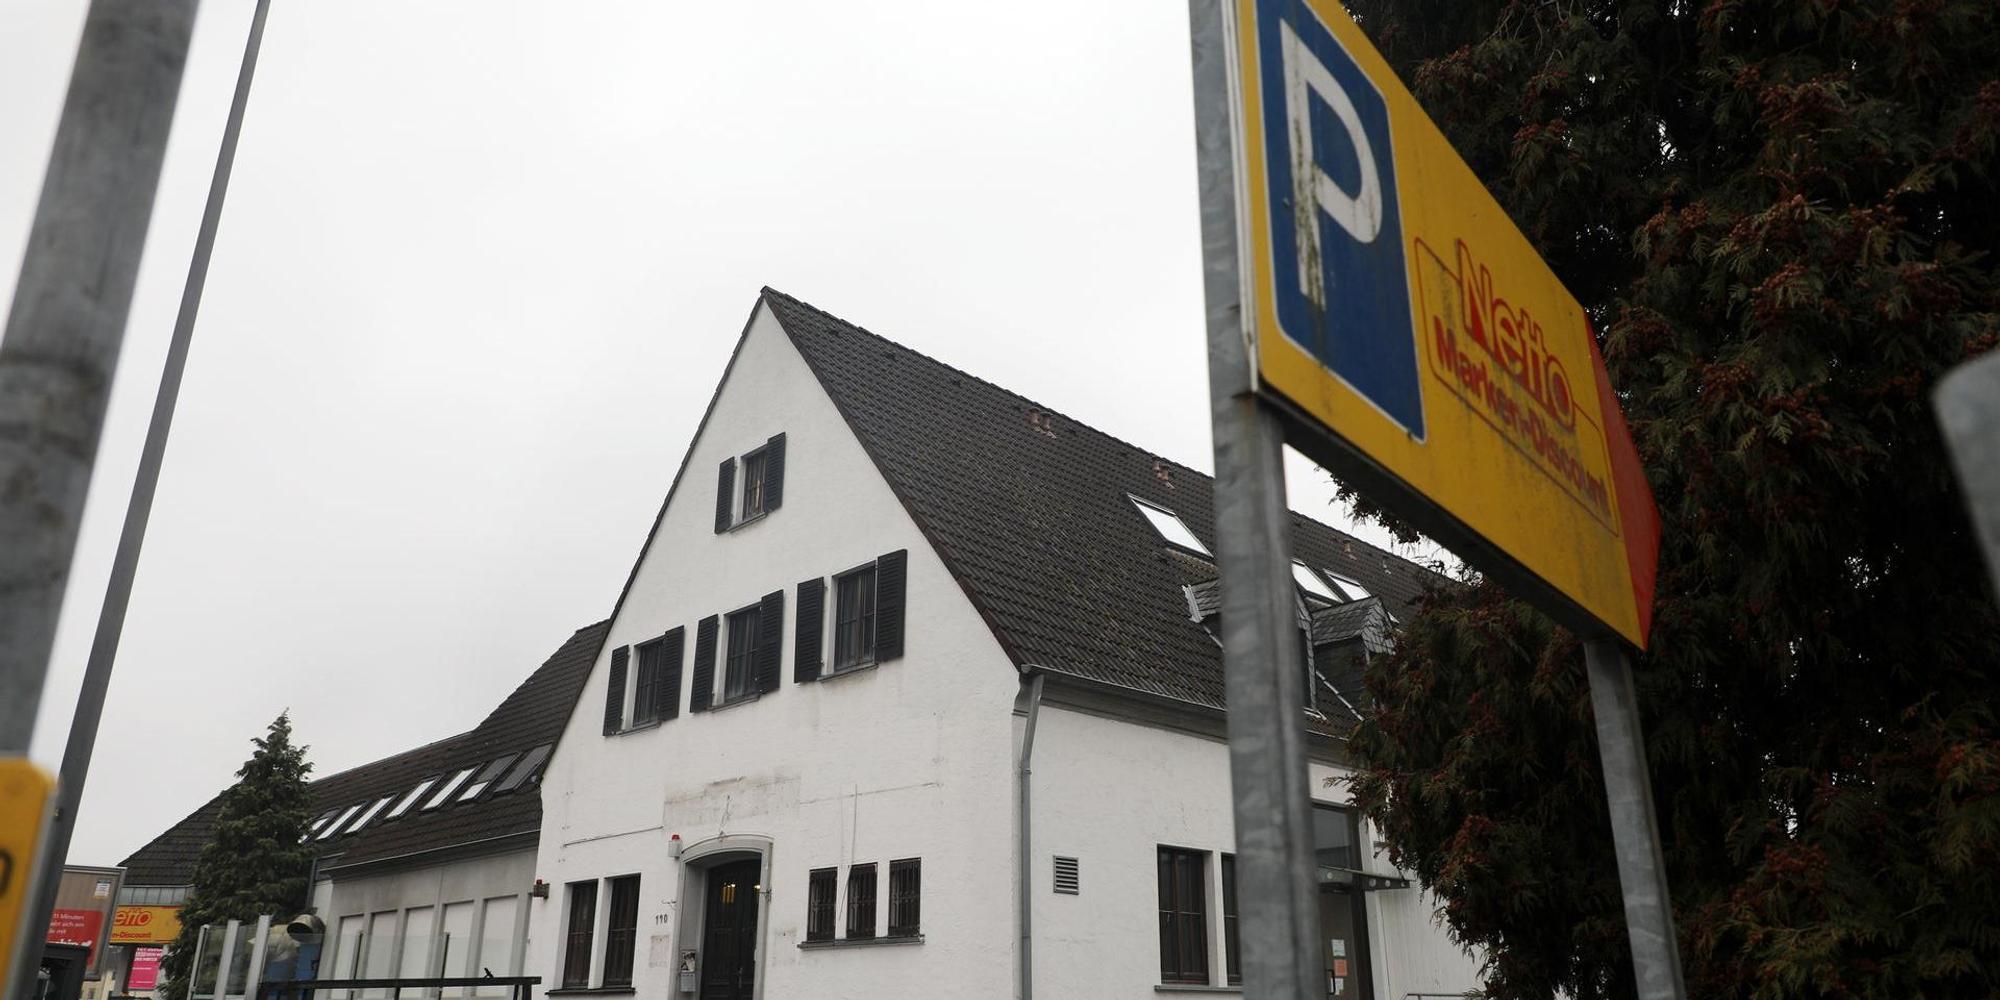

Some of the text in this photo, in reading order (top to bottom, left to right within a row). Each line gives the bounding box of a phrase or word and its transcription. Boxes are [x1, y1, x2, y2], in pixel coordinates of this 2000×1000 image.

[1280, 18, 1383, 312] P
[1433, 314, 1612, 519] Marken-Discount
[1456, 238, 1577, 434] Netto
[111, 931, 152, 939] n-Discount
[114, 907, 153, 927] etto
